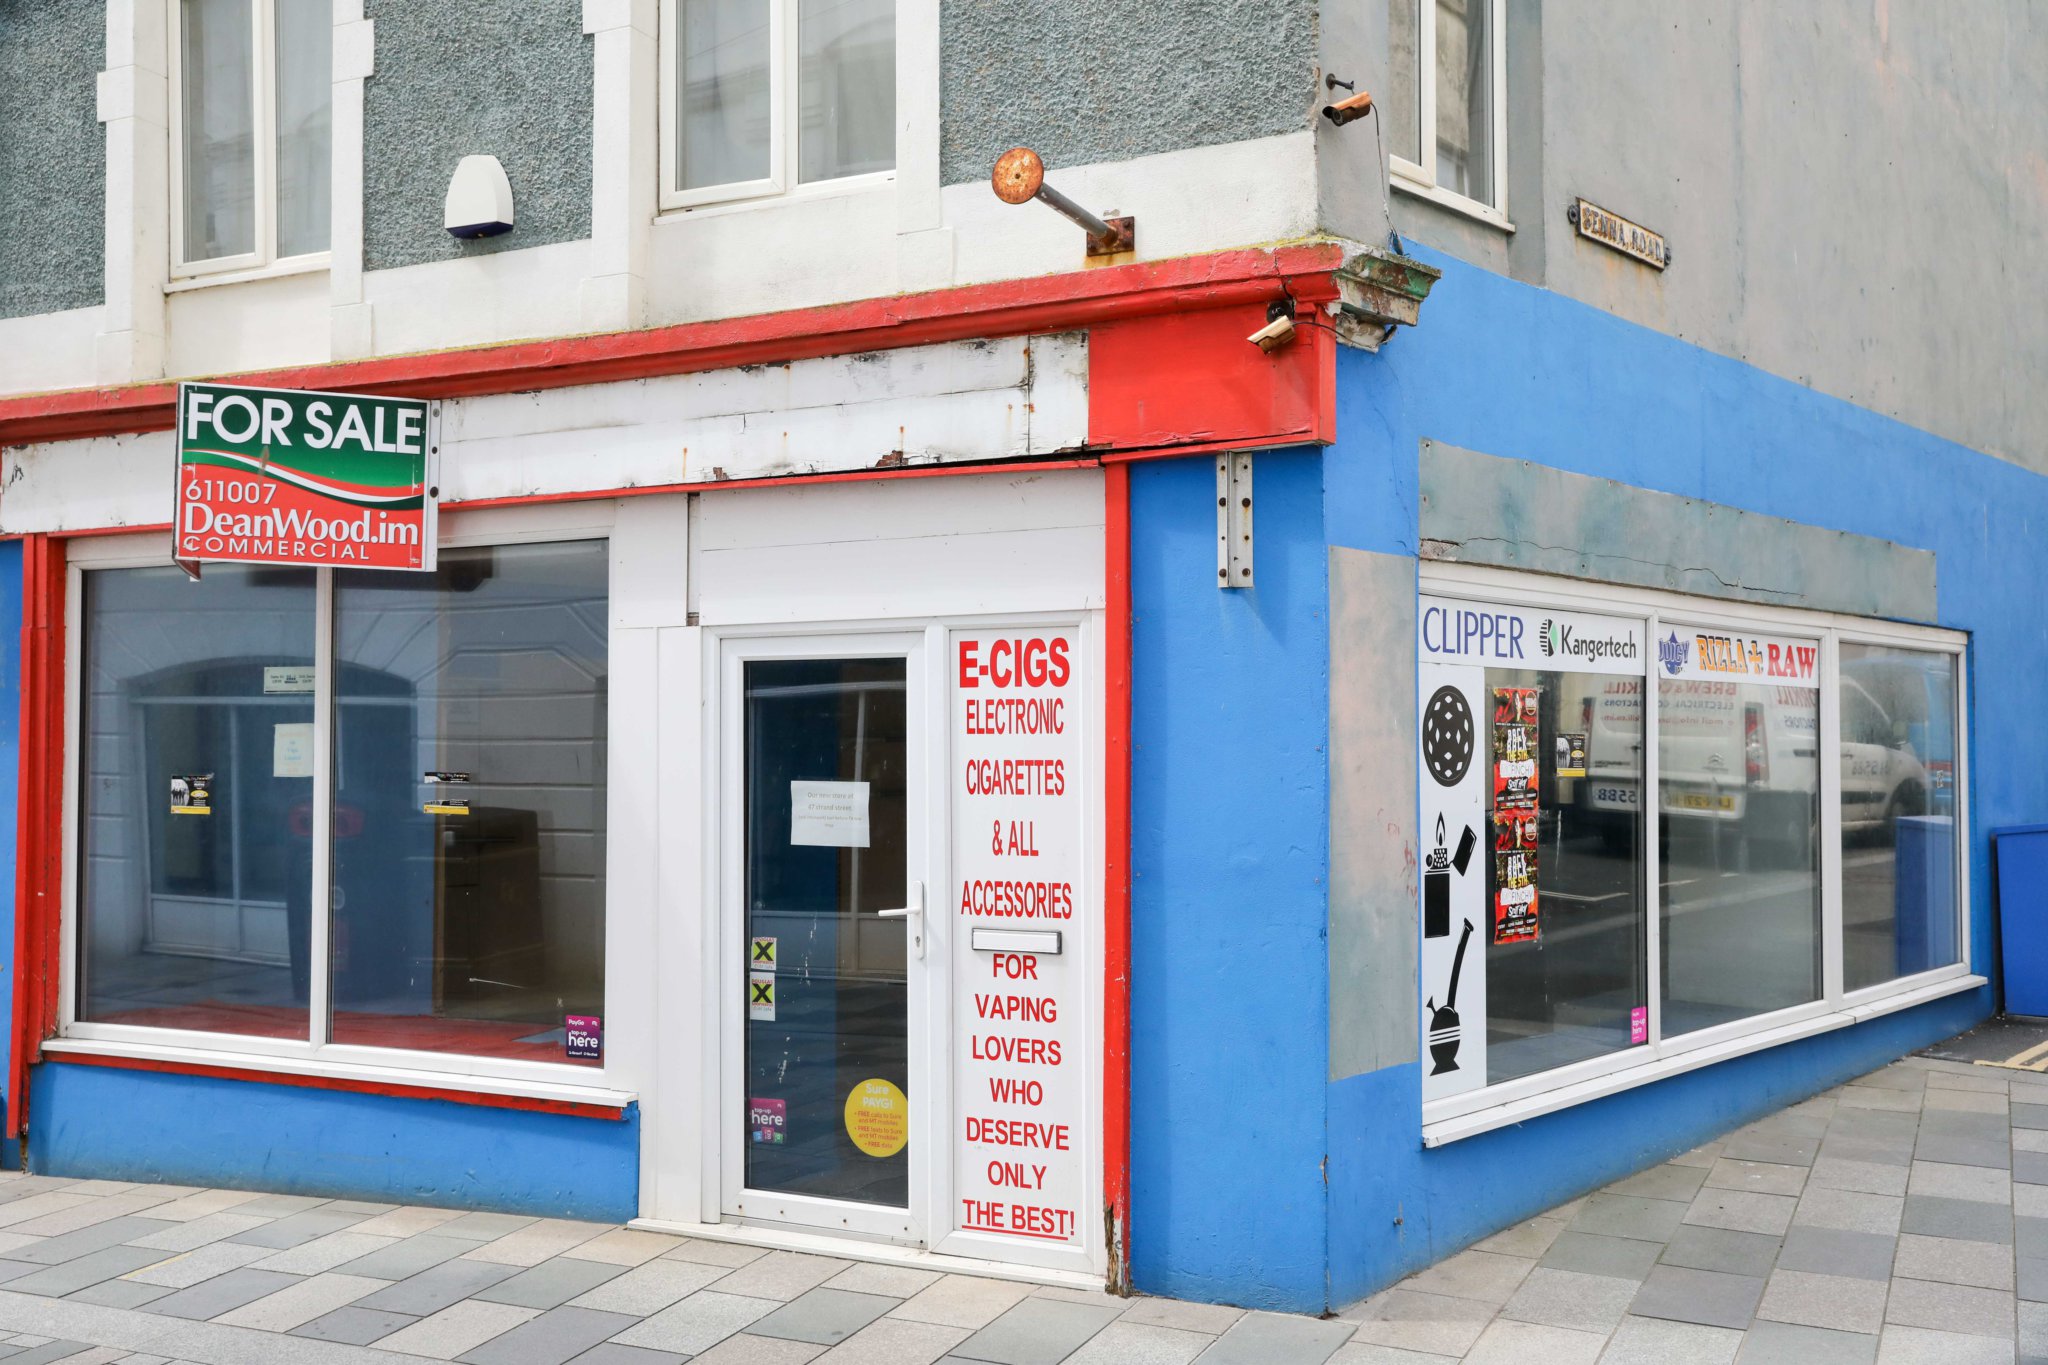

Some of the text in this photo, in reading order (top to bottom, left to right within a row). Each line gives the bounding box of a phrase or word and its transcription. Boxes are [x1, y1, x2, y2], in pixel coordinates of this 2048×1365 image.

[187, 393, 422, 454] FOR SALE
[185, 479, 277, 505] 611007
[184, 502, 419, 545] DeanWood.im
[184, 536, 369, 560] COMMERCIAL
[1423, 607, 1524, 660] CLIPPER
[1561, 625, 1637, 663] Kangertech
[1658, 637, 1689, 664] JUICY
[959, 637, 1070, 688] E-CIGS
[1696, 634, 1747, 674] RIZLA
[1768, 643, 1817, 679] RAW
[966, 698, 1064, 735] ELECTRONIC
[966, 759, 1065, 796] CIGARETTES
[992, 819, 1039, 857] & ALL
[961, 880, 1072, 920] ACCESSORIES
[993, 953, 1038, 980] FOR
[974, 993, 1057, 1023] VAPING
[569, 1032, 598, 1048] here
[972, 1035, 1062, 1066] LOVERS
[866, 1083, 889, 1094] Sure
[989, 1077, 1043, 1106] WHO
[752, 1110, 783, 1125] here
[966, 1117, 1070, 1151] DESERVE
[987, 1160, 1047, 1190] ONLY
[962, 1199, 1075, 1236] THE BEST!
